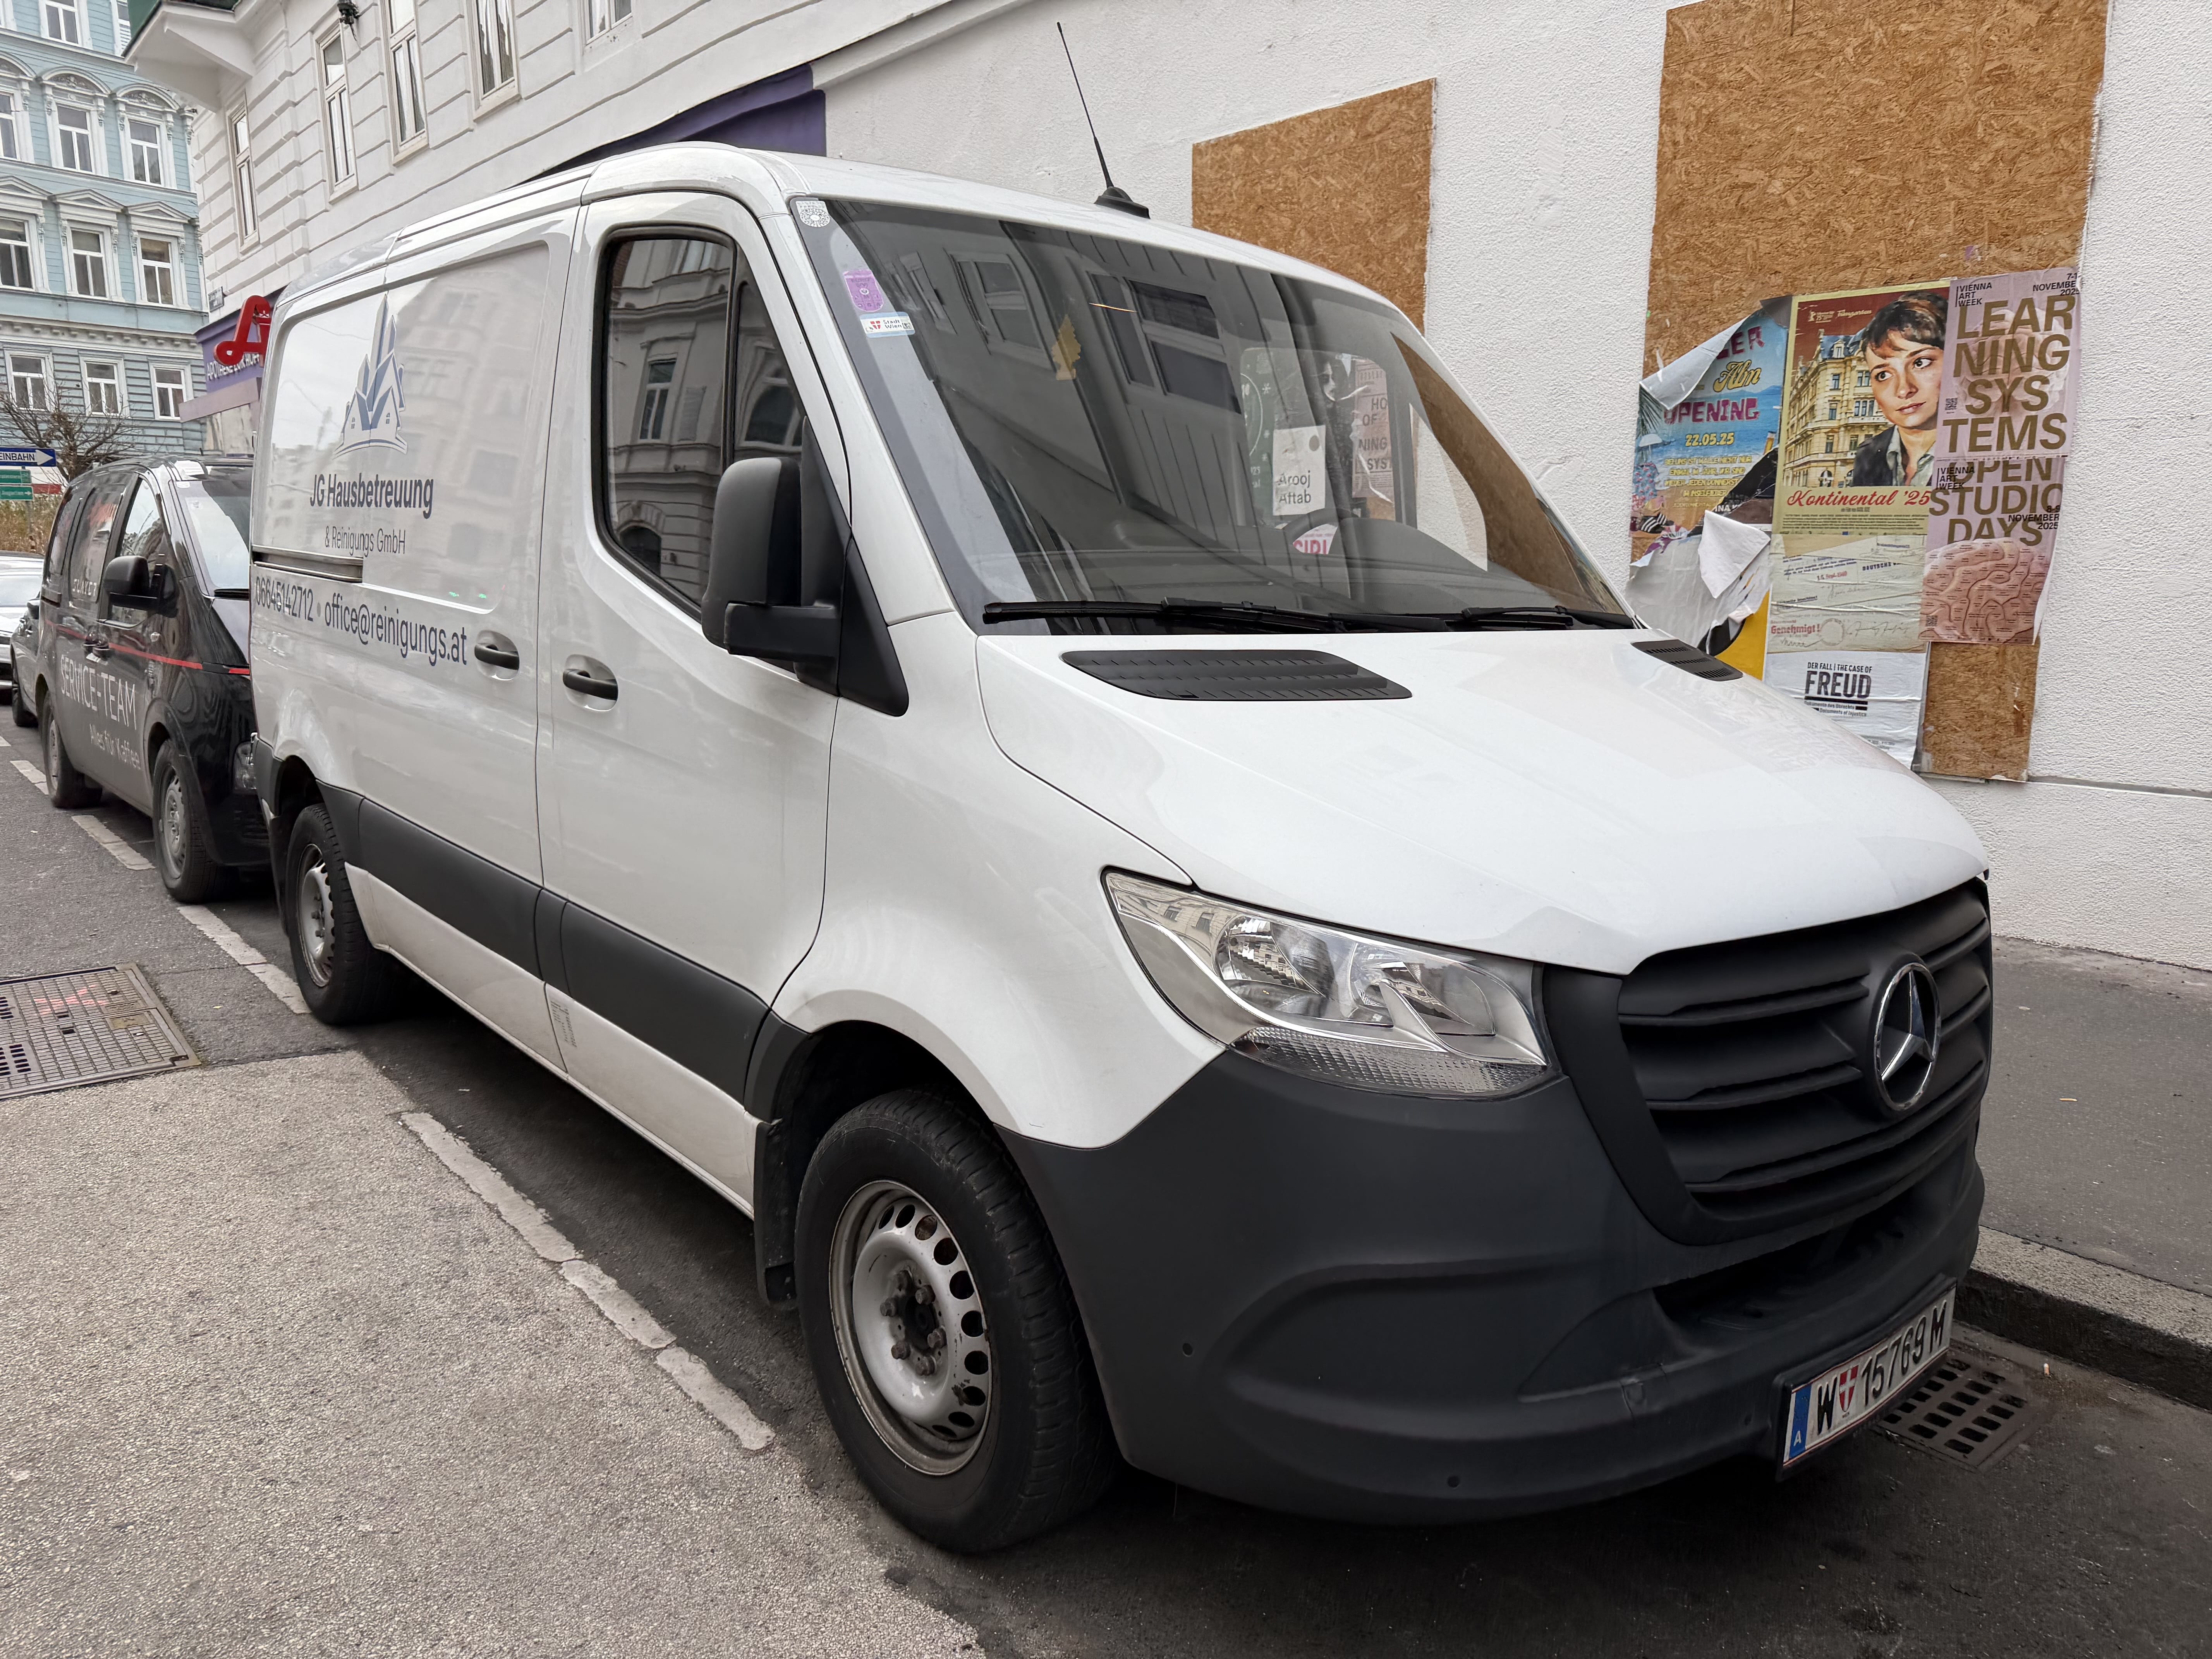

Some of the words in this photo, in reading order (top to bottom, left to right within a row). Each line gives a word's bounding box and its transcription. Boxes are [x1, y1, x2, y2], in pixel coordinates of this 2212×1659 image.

[1959, 282, 1992, 292] VIENNA
[1959, 291, 1976, 300] ART
[2033, 280, 2076, 291] NOVEMBE
[1957, 295, 2076, 339] LEAR
[1958, 298, 1982, 307] WEEK
[1953, 334, 2070, 378] NING
[1713, 359, 1762, 392] Alm
[1965, 375, 2050, 414] SYS
[1664, 398, 1760, 425] OPENING
[1685, 433, 1735, 447] 22.05.25
[1942, 413, 2067, 453] TEMS
[1948, 458, 2052, 483] OPEN
[310, 475, 325, 507] JG
[328, 473, 434, 519] Hausbetreuung
[1787, 490, 1898, 506] Kontinental
[1904, 490, 1931, 505] '25
[1929, 483, 2063, 516] STUDIO
[325, 527, 330, 548] &
[331, 526, 374, 558] Reinigungs
[377, 528, 406, 554] GmbH
[1947, 518, 2042, 546] DAYS
[256, 576, 313, 622] 06645142712
[325, 592, 467, 666] office@reinigungs.at
[61, 654, 136, 730] SERVICE-TEAM
[1805, 670, 1872, 699] FREUD
[1817, 1376, 1838, 1435] W
[1862, 1316, 1927, 1406] 15769
[1793, 1430, 1802, 1447] A
